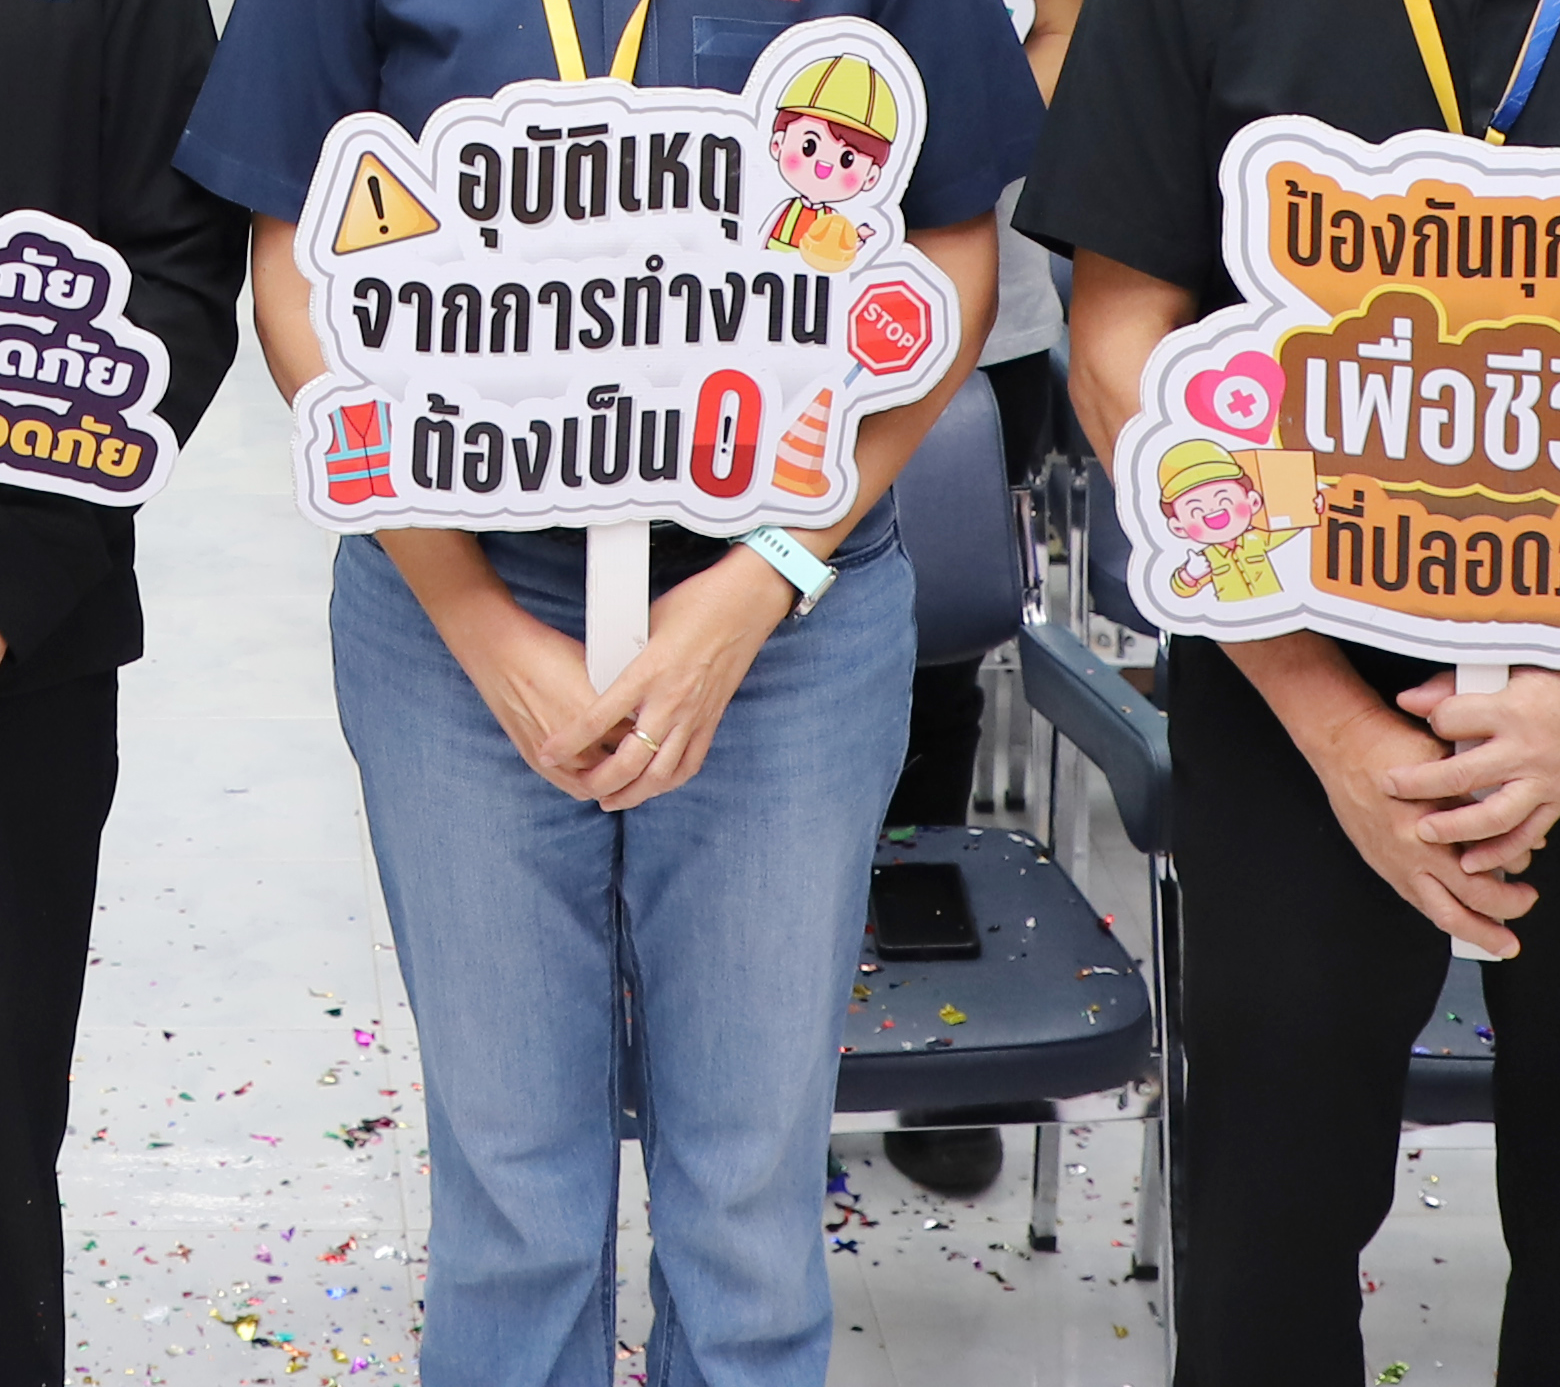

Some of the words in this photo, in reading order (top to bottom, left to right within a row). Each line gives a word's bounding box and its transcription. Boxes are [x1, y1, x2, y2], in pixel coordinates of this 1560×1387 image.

[458, 124, 744, 249] อุบัติเหตุ
[352, 253, 832, 356] จากการทำงาน
[863, 302, 915, 348] STOP
